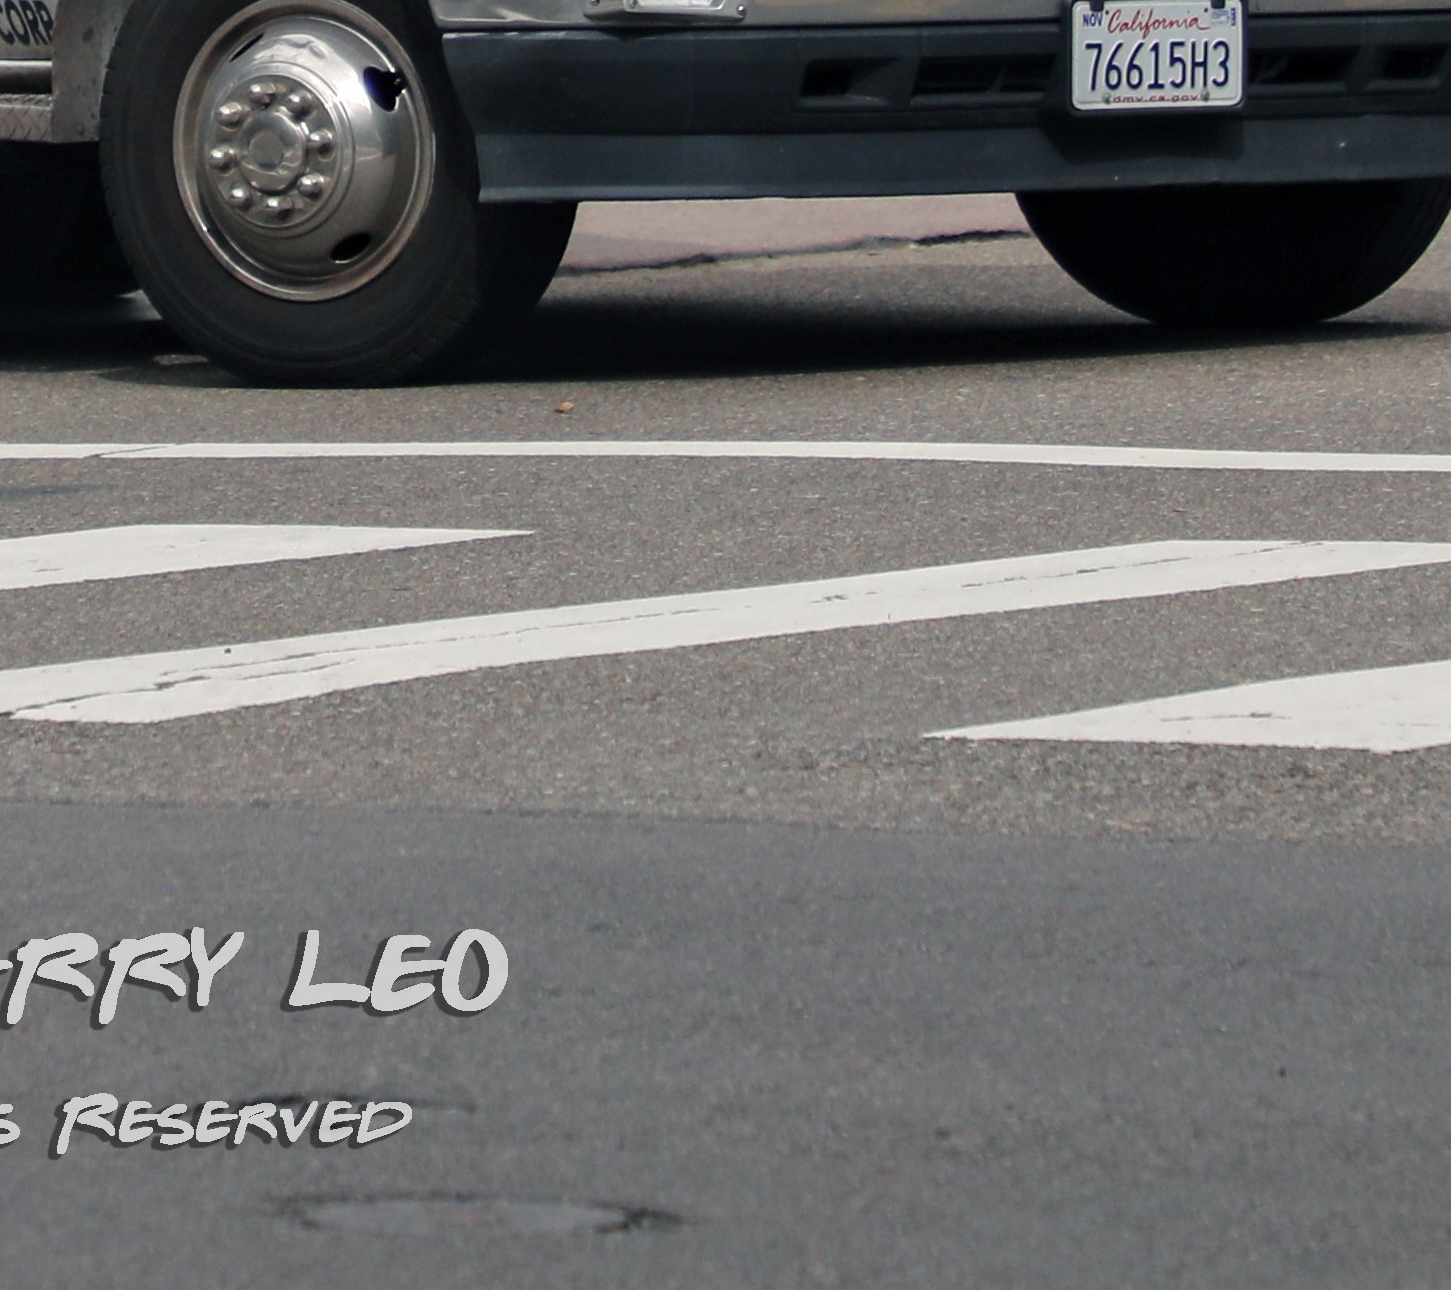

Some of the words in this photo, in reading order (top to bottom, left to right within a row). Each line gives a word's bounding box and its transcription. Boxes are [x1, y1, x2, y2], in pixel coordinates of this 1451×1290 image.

[1082, 13, 1104, 27] NOV
[1107, 9, 1211, 39] California
[1085, 40, 1230, 92] 76615H3
